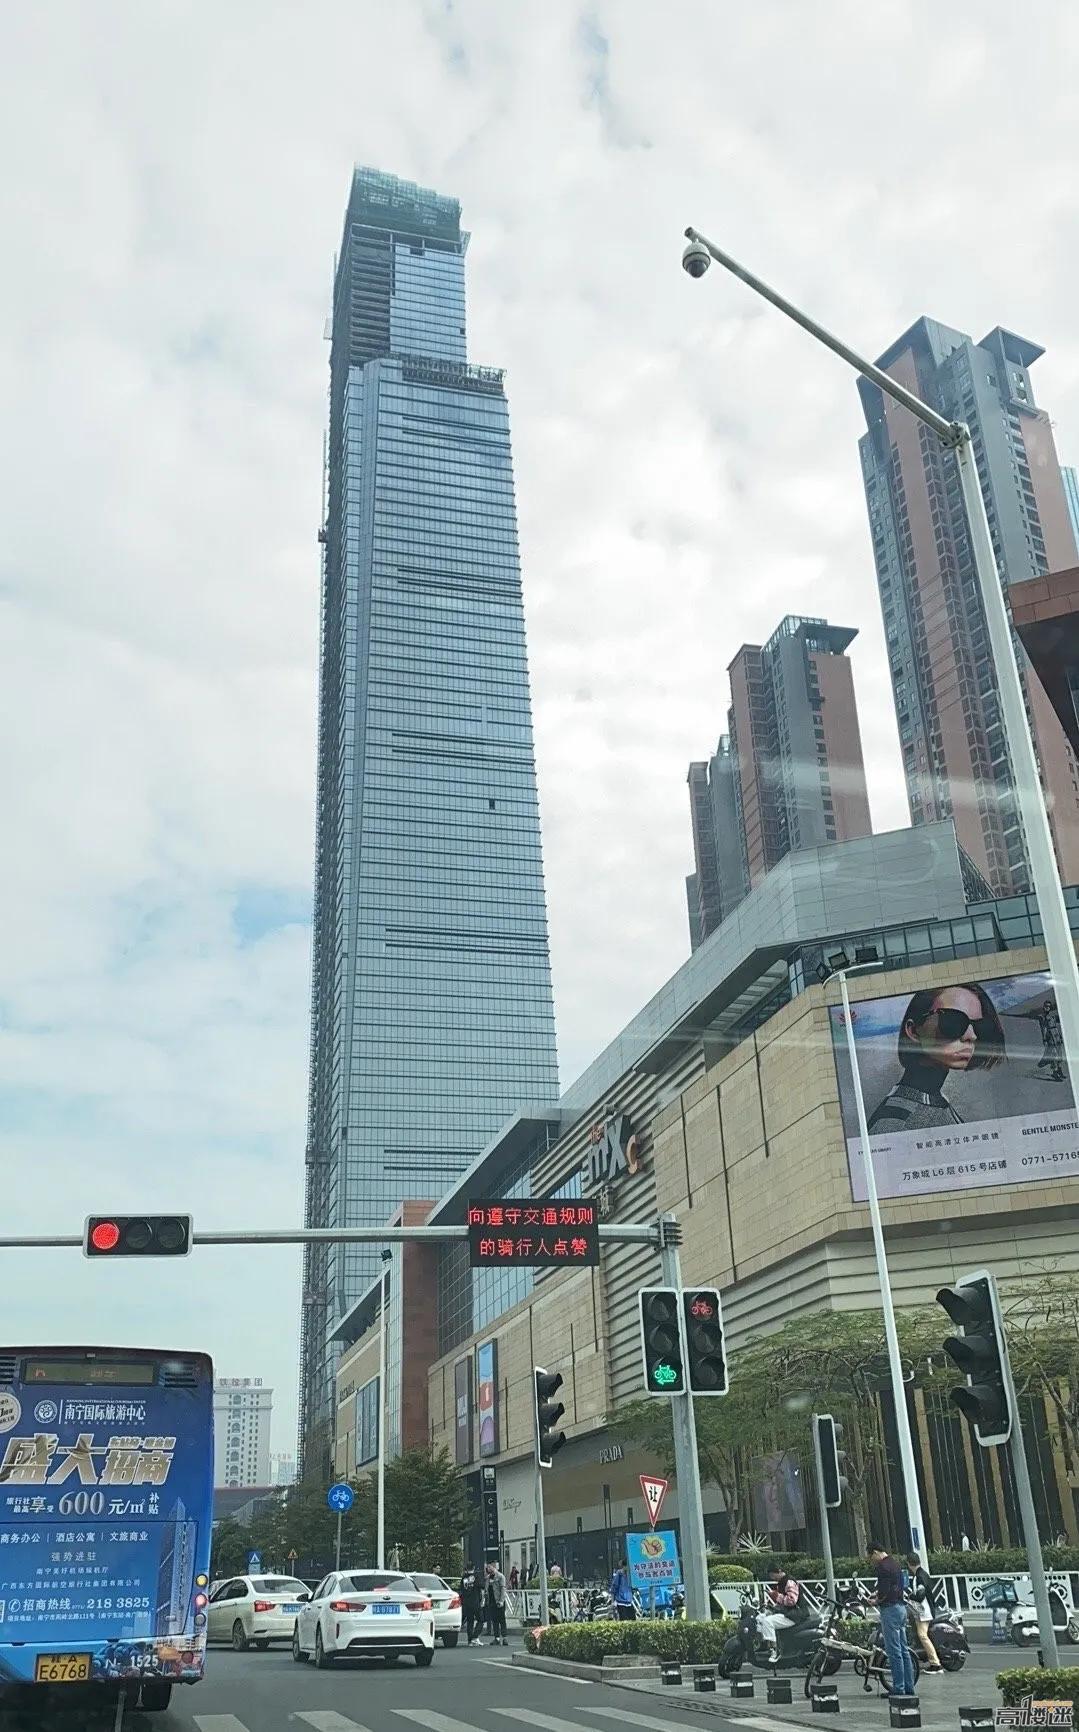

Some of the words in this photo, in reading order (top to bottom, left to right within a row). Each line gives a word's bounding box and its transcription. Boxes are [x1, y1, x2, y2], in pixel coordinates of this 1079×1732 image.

[469, 1207, 593, 1226] 向遵守交通规则
[480, 1237, 588, 1257] 的骑行人点赞
[65, 1404, 146, 1421] 南宁国际旅游中心
[599, 1445, 623, 1464] PRADA
[649, 1485, 658, 1503] 让
[58, 1491, 105, 1516] 600
[0, 1533, 41, 1544] 商务办公
[55, 1531, 96, 1543] 酒店公寓
[109, 1531, 149, 1542] 文旅商业
[51, 1551, 97, 1563] 强势进驻
[23, 1597, 71, 1612] 招商热线
[87, 1598, 112, 1609] 218
[116, 1597, 150, 1608] 3825
[130, 1655, 159, 1668] 1525
[39, 1663, 87, 1680] E6768
